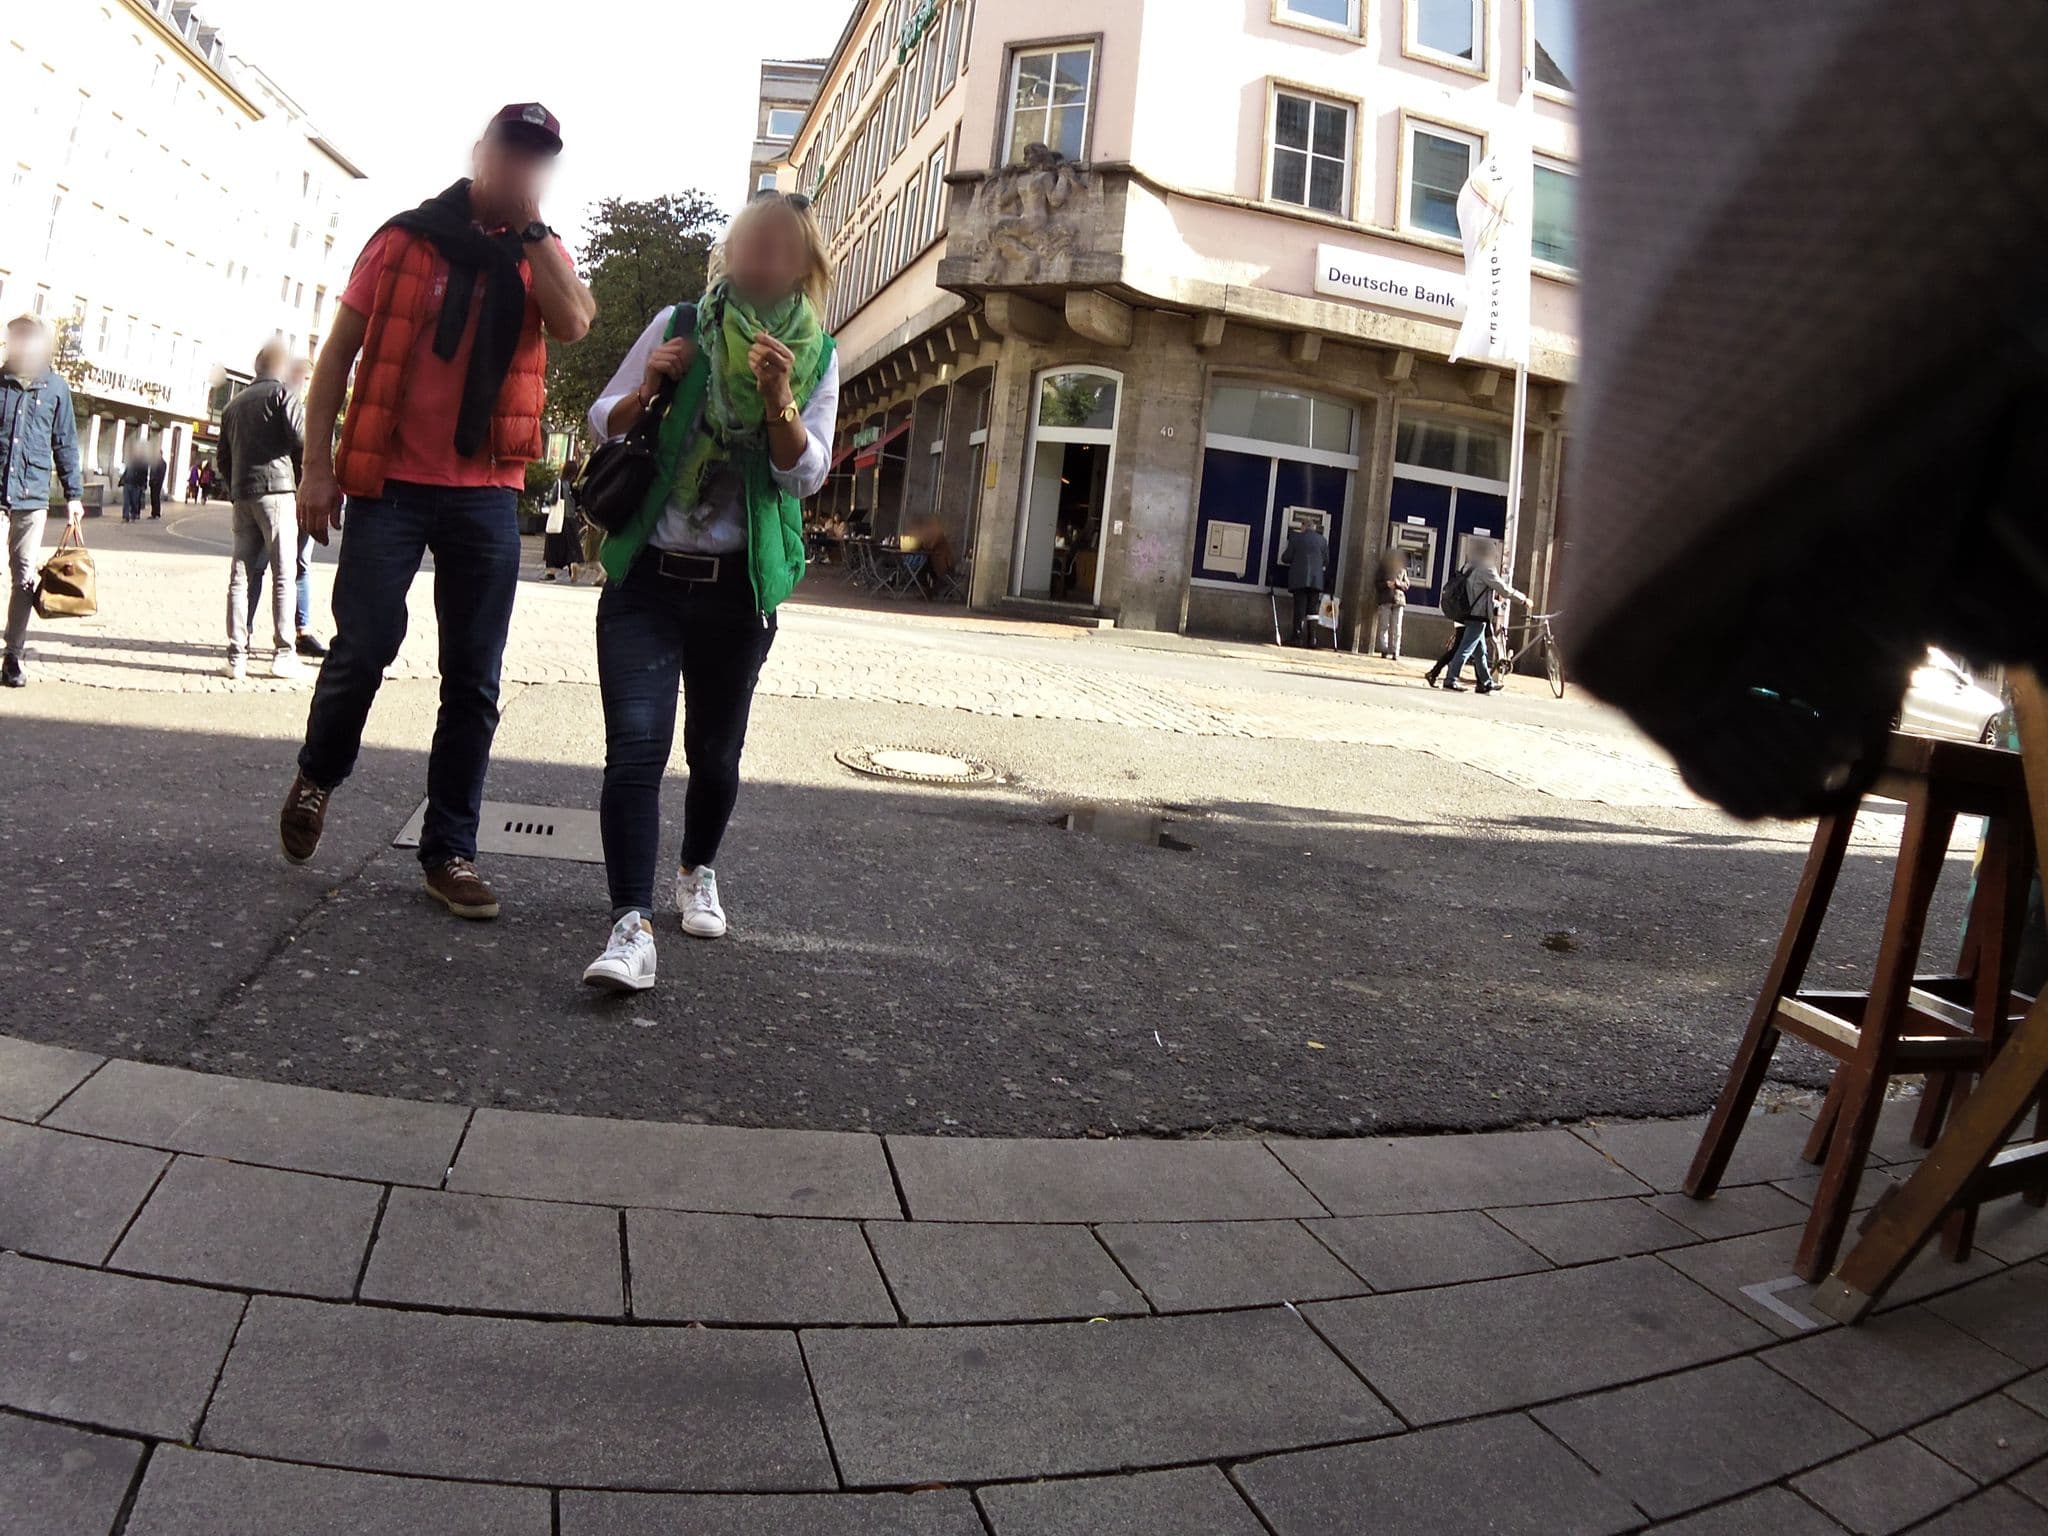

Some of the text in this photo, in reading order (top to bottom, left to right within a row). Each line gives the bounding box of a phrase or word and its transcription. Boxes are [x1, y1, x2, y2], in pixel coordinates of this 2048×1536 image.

[1328, 267, 1455, 307] Deutsche Bank
[1160, 426, 1174, 437] 40
